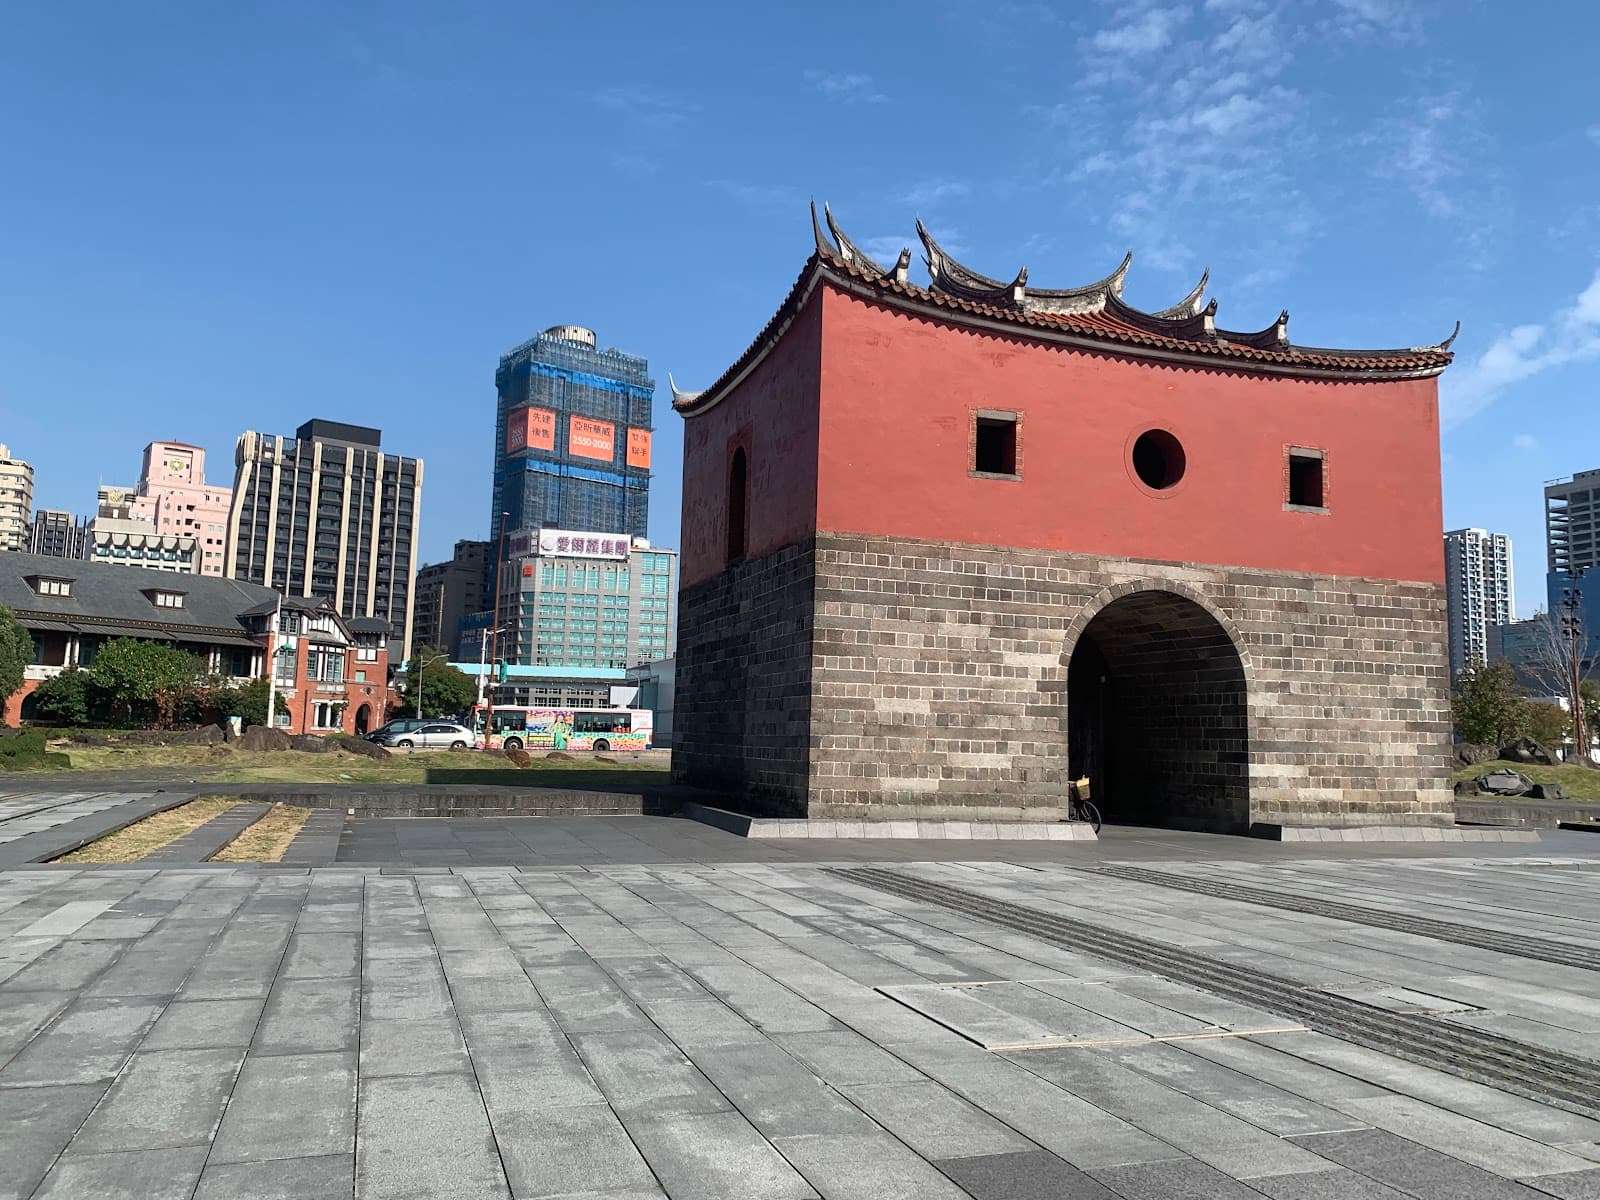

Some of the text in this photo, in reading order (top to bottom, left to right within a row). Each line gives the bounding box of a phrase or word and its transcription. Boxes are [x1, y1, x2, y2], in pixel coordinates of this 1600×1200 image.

[533, 412, 551, 424] 先建
[572, 435, 611, 450] 2550-2000
[556, 536, 629, 556] 愛爾麗集團
